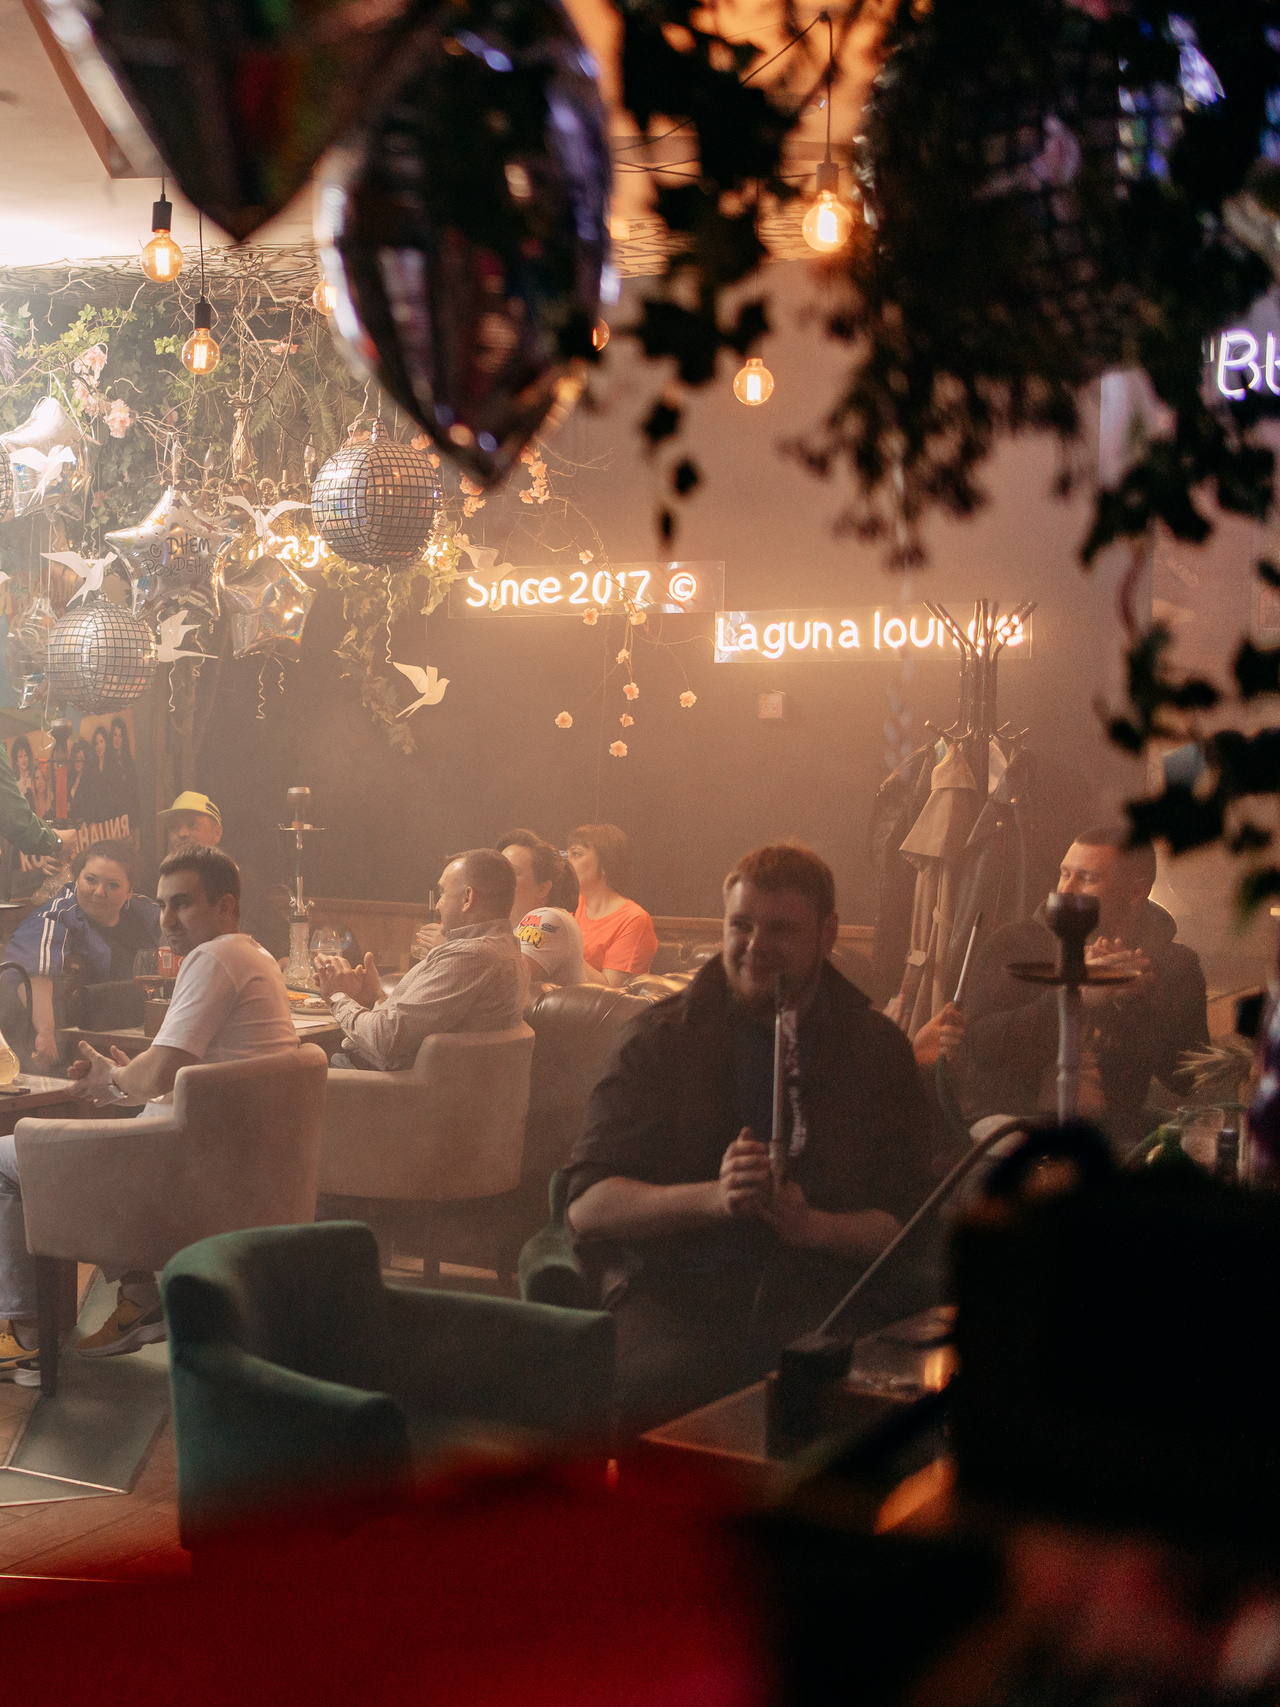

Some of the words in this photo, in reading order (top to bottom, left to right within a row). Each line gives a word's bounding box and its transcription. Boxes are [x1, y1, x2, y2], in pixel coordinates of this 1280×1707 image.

[466, 575, 563, 608] Since
[568, 570, 651, 605] 2017
[717, 617, 860, 660] Laguna
[519, 914, 542, 927] OM
[516, 925, 547, 950] ERRY
